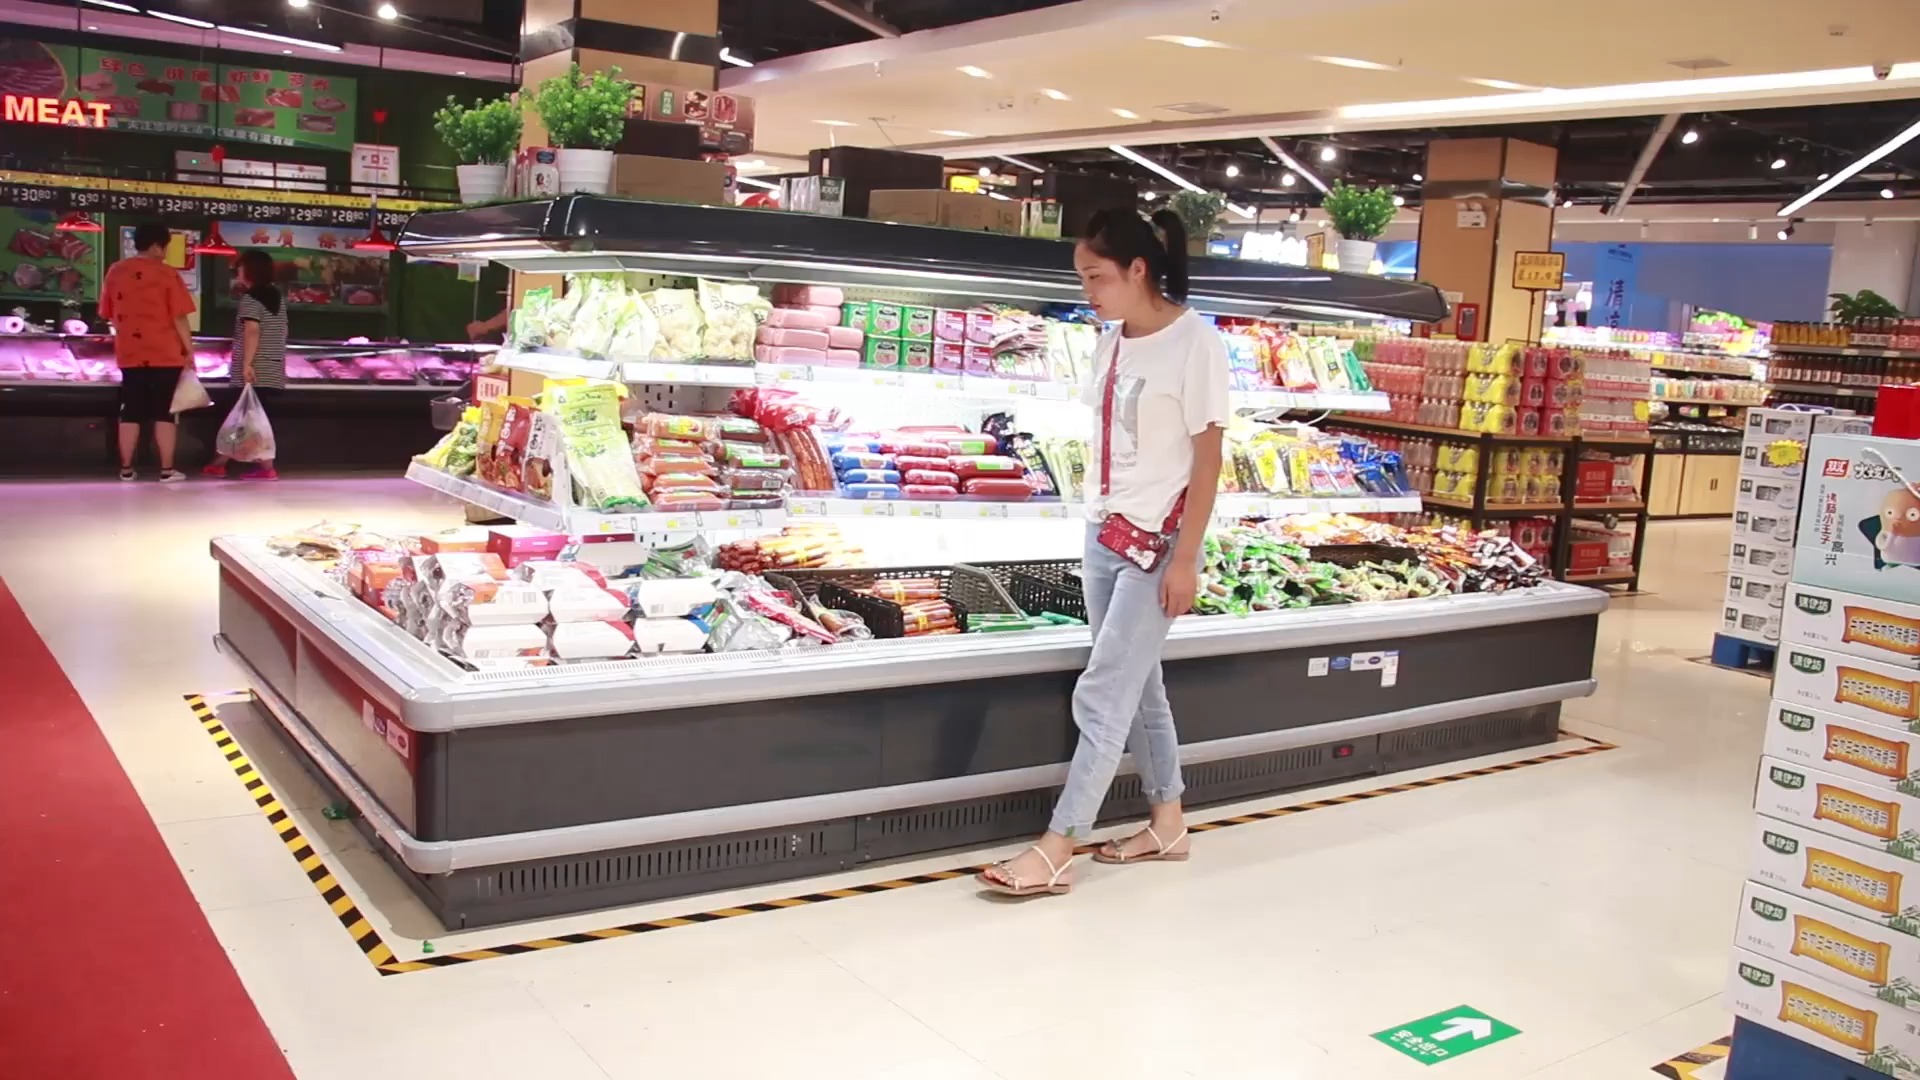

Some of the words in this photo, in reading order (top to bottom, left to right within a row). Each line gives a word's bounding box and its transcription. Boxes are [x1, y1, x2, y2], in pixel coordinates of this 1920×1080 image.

[5, 95, 111, 127] MEAT
[1826, 460, 1847, 473] 双汇
[1394, 1030, 1448, 1057] 安全出口
